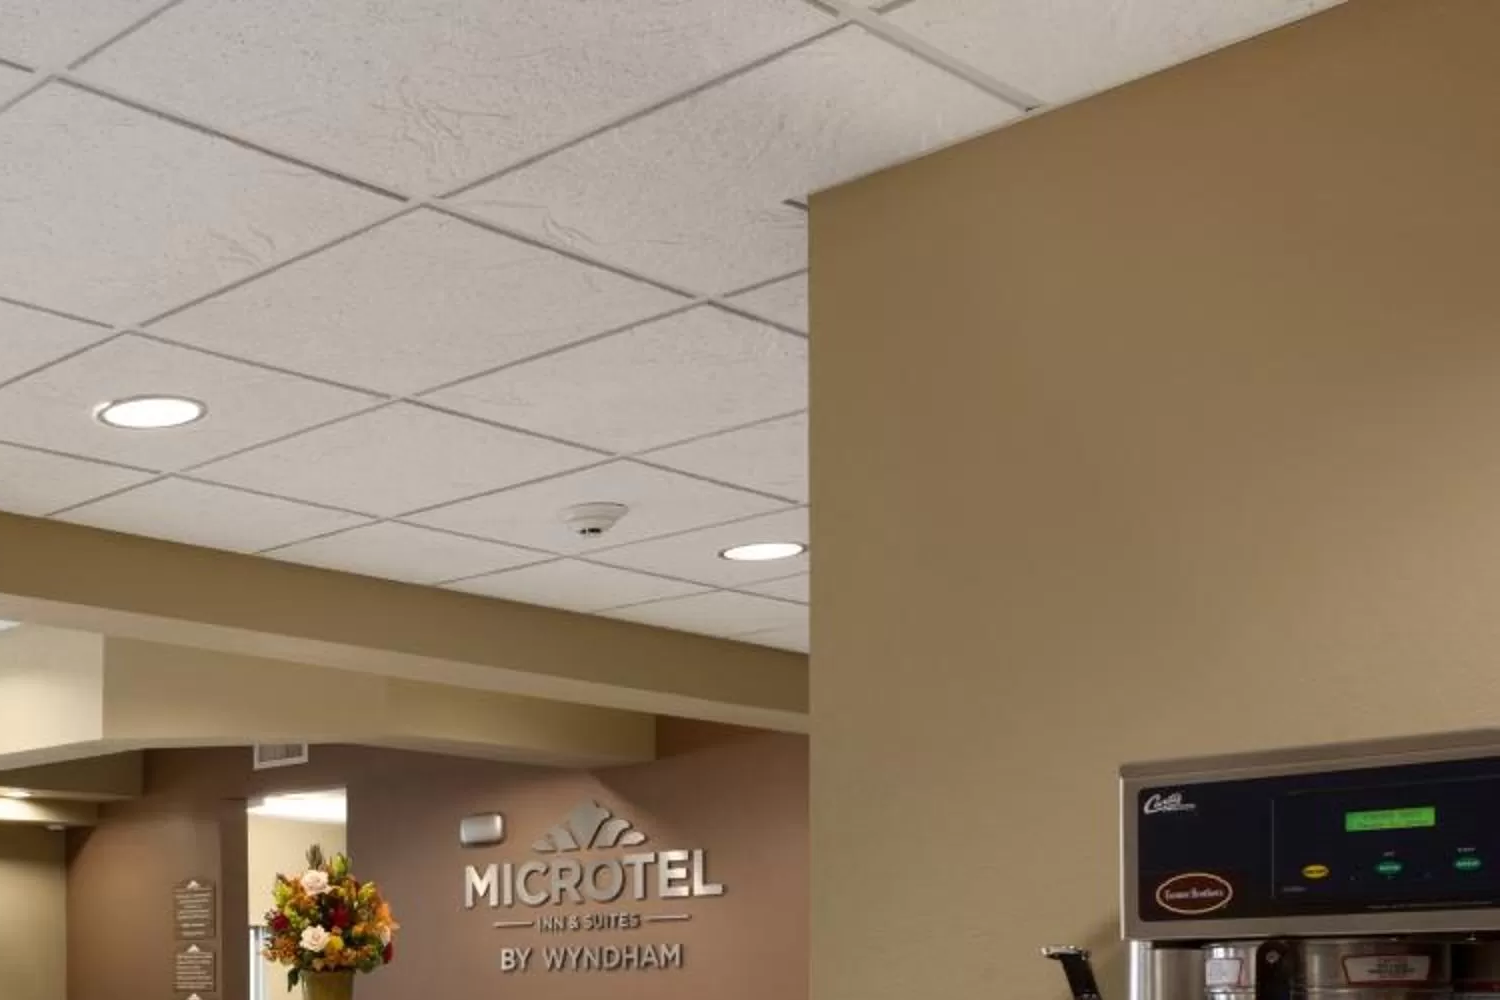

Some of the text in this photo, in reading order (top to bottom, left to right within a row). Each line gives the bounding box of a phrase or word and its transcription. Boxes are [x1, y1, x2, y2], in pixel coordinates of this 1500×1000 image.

[464, 849, 727, 908] MICROTEL
[538, 911, 642, 934] INN & SUITES
[501, 943, 684, 972] BY WYNDHAM
